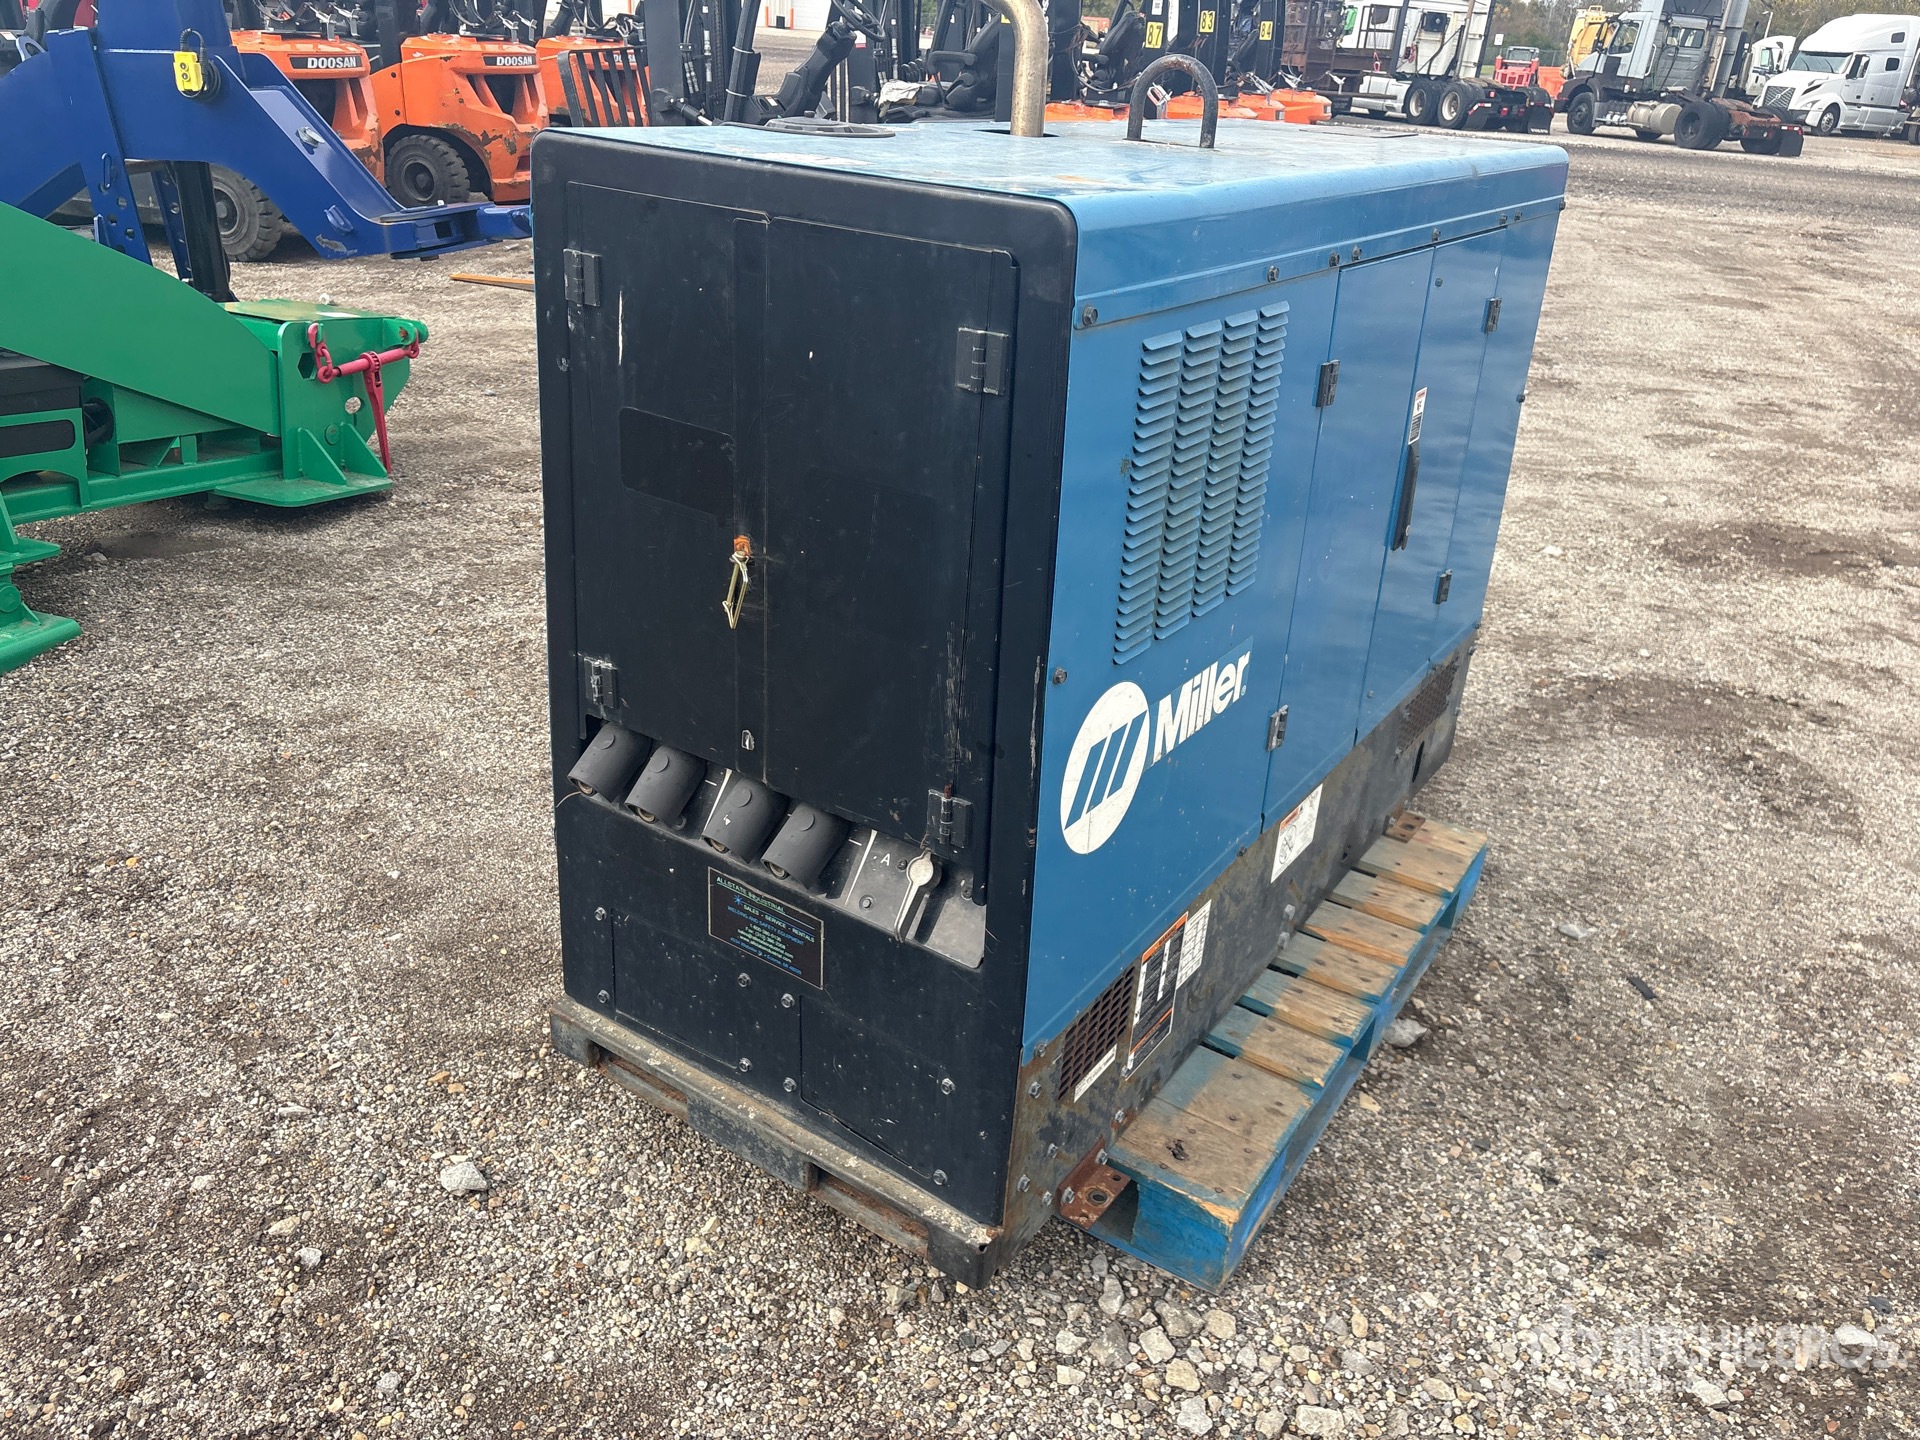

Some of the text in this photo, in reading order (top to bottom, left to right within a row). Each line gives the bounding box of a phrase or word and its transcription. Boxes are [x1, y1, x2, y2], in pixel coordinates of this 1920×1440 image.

[1201, 11, 1214, 30] 83
[1147, 24, 1163, 46] 87
[1261, 22, 1272, 38] 84
[307, 57, 357, 69] DOOSAN
[496, 56, 533, 66] DOOSAN
[1152, 650, 1251, 766] Miller
[880, 853, 891, 866] A
[744, 905, 814, 943] SALES SERVICE RENTALS
[749, 916, 758, 924] AND
[759, 921, 776, 932] SAFETY
